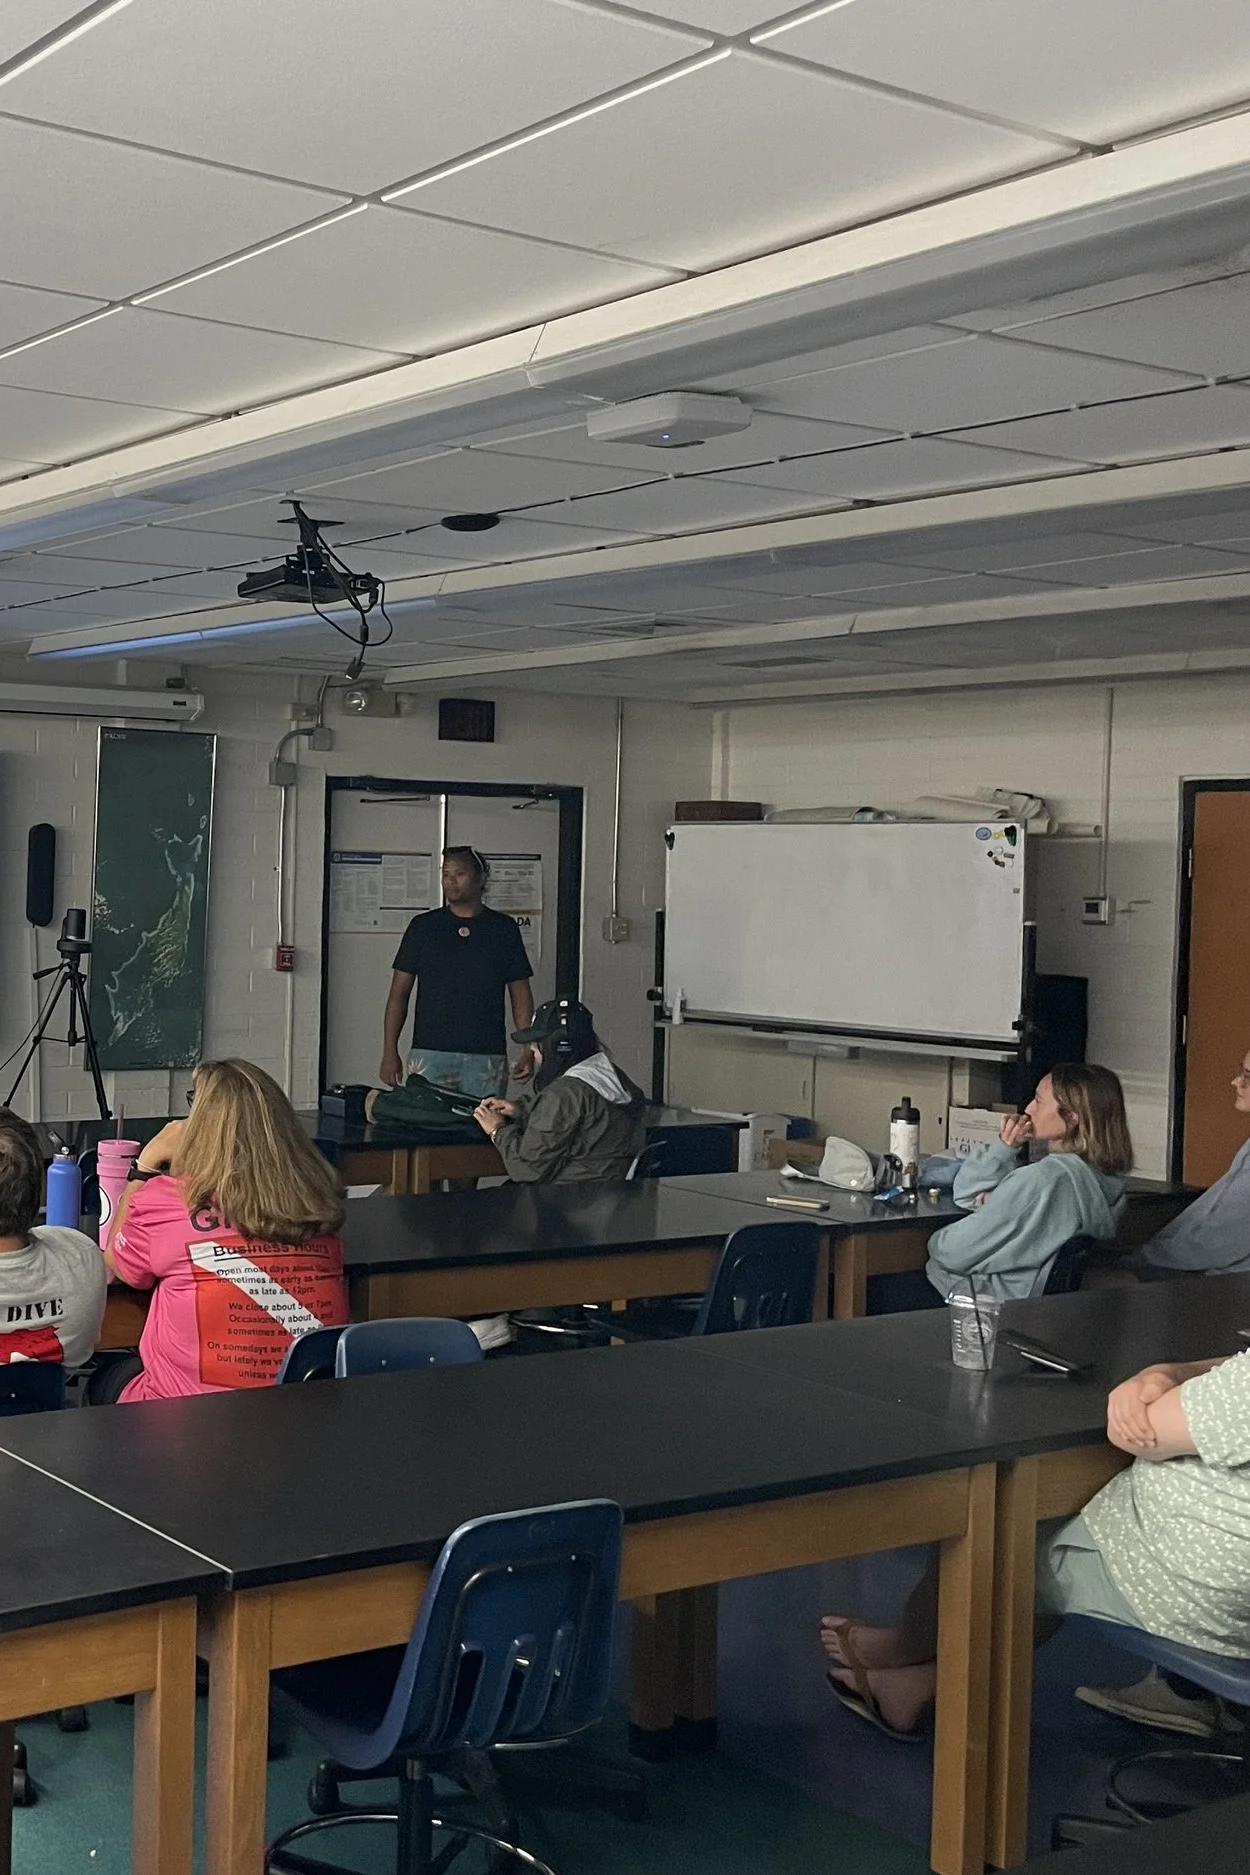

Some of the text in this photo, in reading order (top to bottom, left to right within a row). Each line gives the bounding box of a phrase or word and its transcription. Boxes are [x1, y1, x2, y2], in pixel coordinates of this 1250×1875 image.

[213, 1241, 289, 1257] Business
[217, 1266, 242, 1276] Open
[244, 1266, 267, 1274] most
[270, 1265, 289, 1274] days
[262, 1287, 277, 1295] late
[7, 1299, 63, 1322] DIVE
[228, 1302, 244, 1311] We
[246, 1302, 269, 1311] close
[271, 1302, 296, 1311] about
[229, 1314, 285, 1324] Occasionally
[288, 1313, 312, 1323] about
[228, 1328, 275, 1336] sometimes
[290, 1326, 305, 1335] late
[207, 1341, 220, 1350] On
[217, 1354, 231, 1362] but
